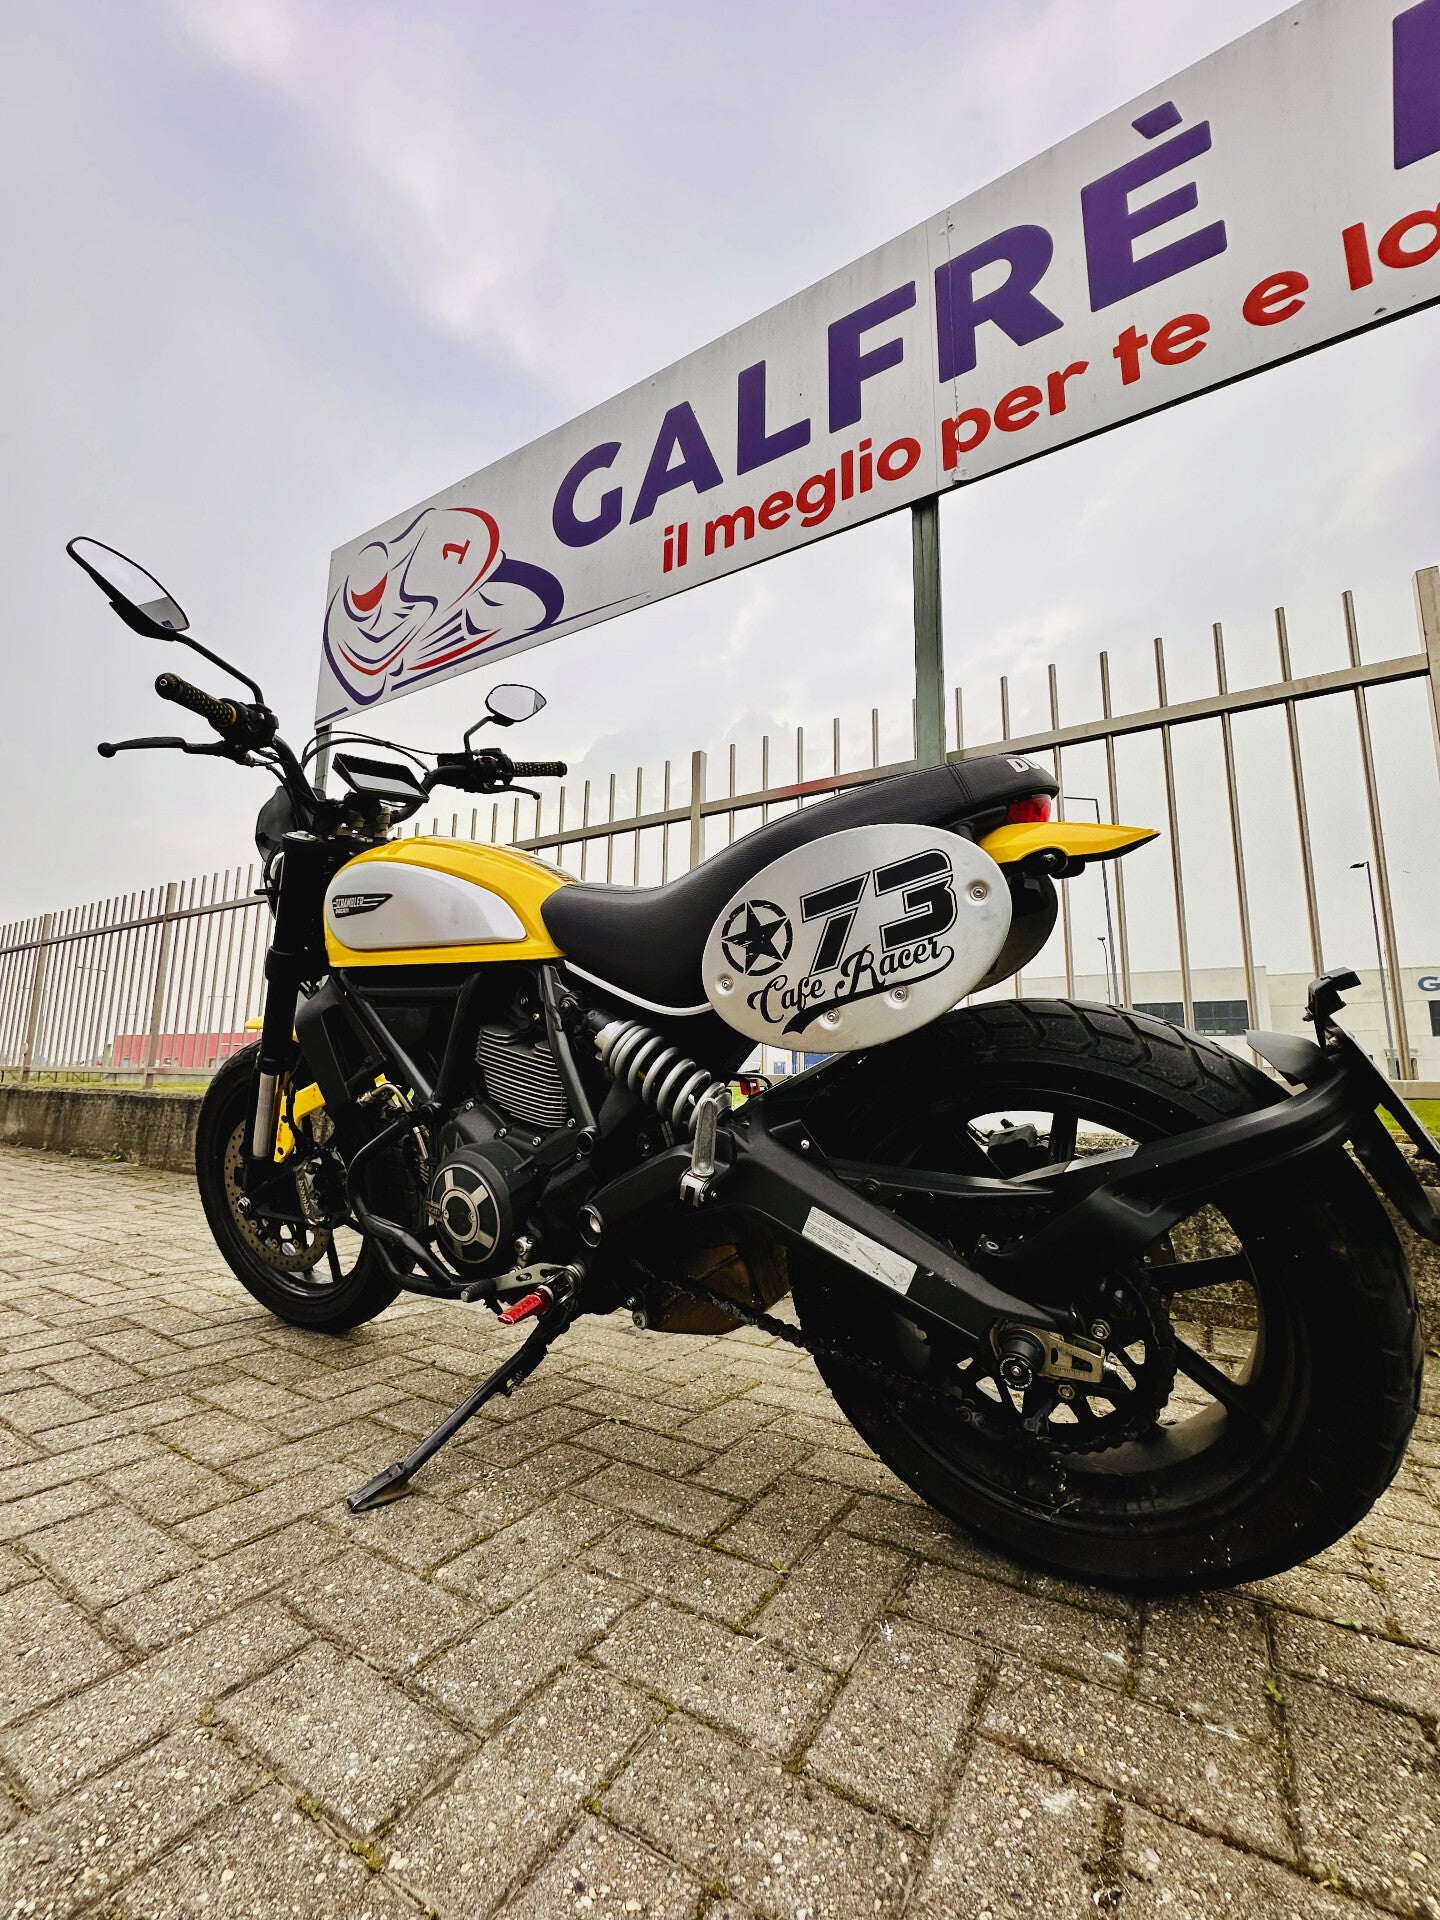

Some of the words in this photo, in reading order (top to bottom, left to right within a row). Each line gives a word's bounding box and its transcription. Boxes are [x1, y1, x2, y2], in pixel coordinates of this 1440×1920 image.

[553, 105, 1226, 548] GALFRÈ
[663, 523, 688, 574] il
[704, 437, 921, 557] meglio
[941, 361, 1089, 472] per
[1113, 313, 1211, 386] te
[1242, 270, 1309, 327] e
[442, 538, 471, 566] 1
[799, 848, 959, 977] 73
[746, 974, 826, 1025] Cafe
[835, 937, 943, 997] Racer
